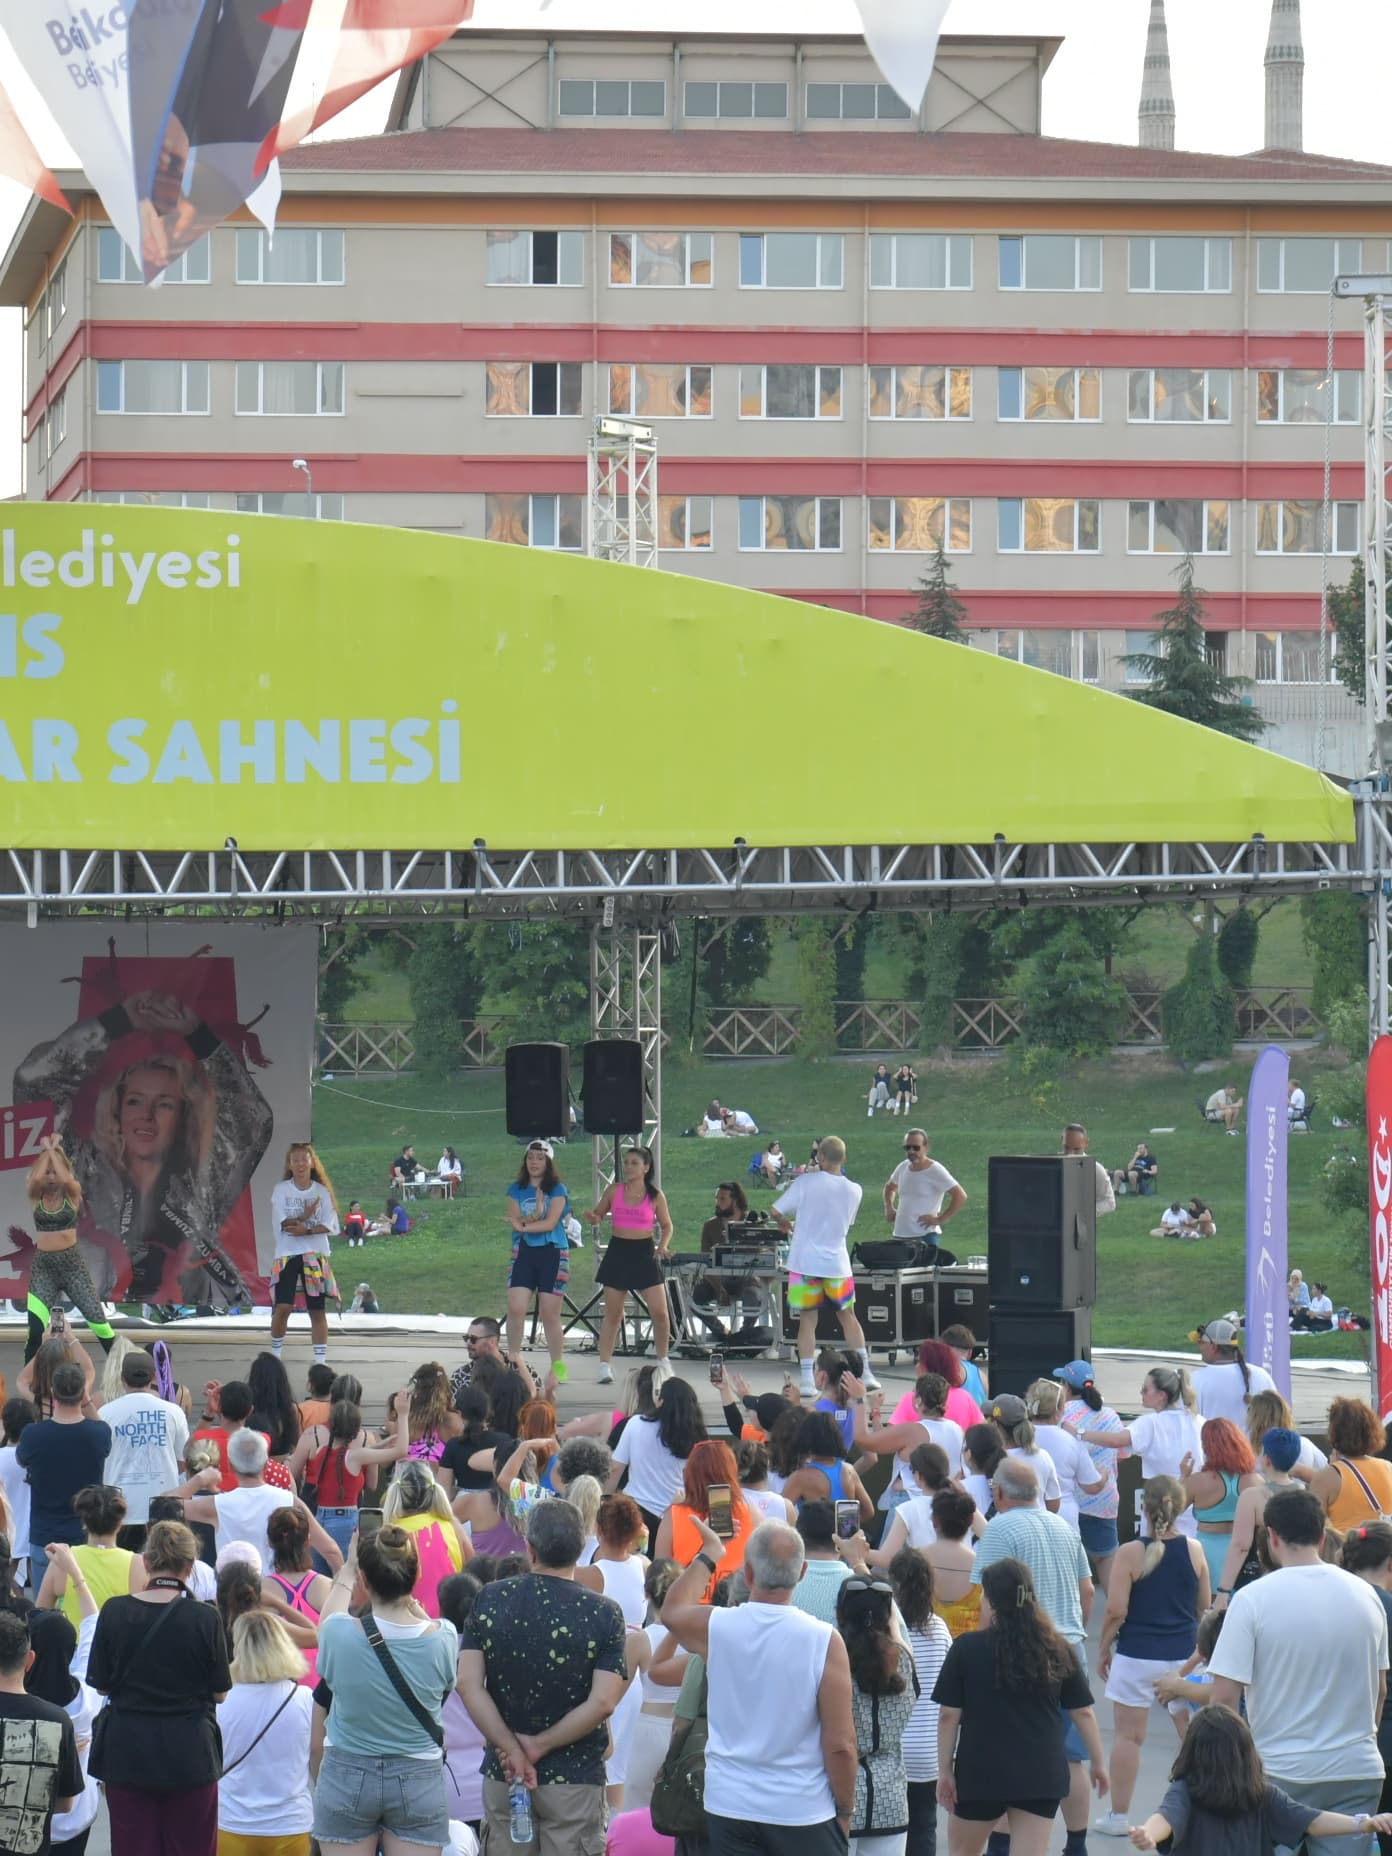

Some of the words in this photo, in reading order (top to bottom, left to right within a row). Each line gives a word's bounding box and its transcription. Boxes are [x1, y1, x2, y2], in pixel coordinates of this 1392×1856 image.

[107, 699, 461, 784] SAHNESİ
[136, 1410, 166, 1422] THE
[115, 1421, 167, 1437] NORTH
[130, 1434, 168, 1448] FACE
